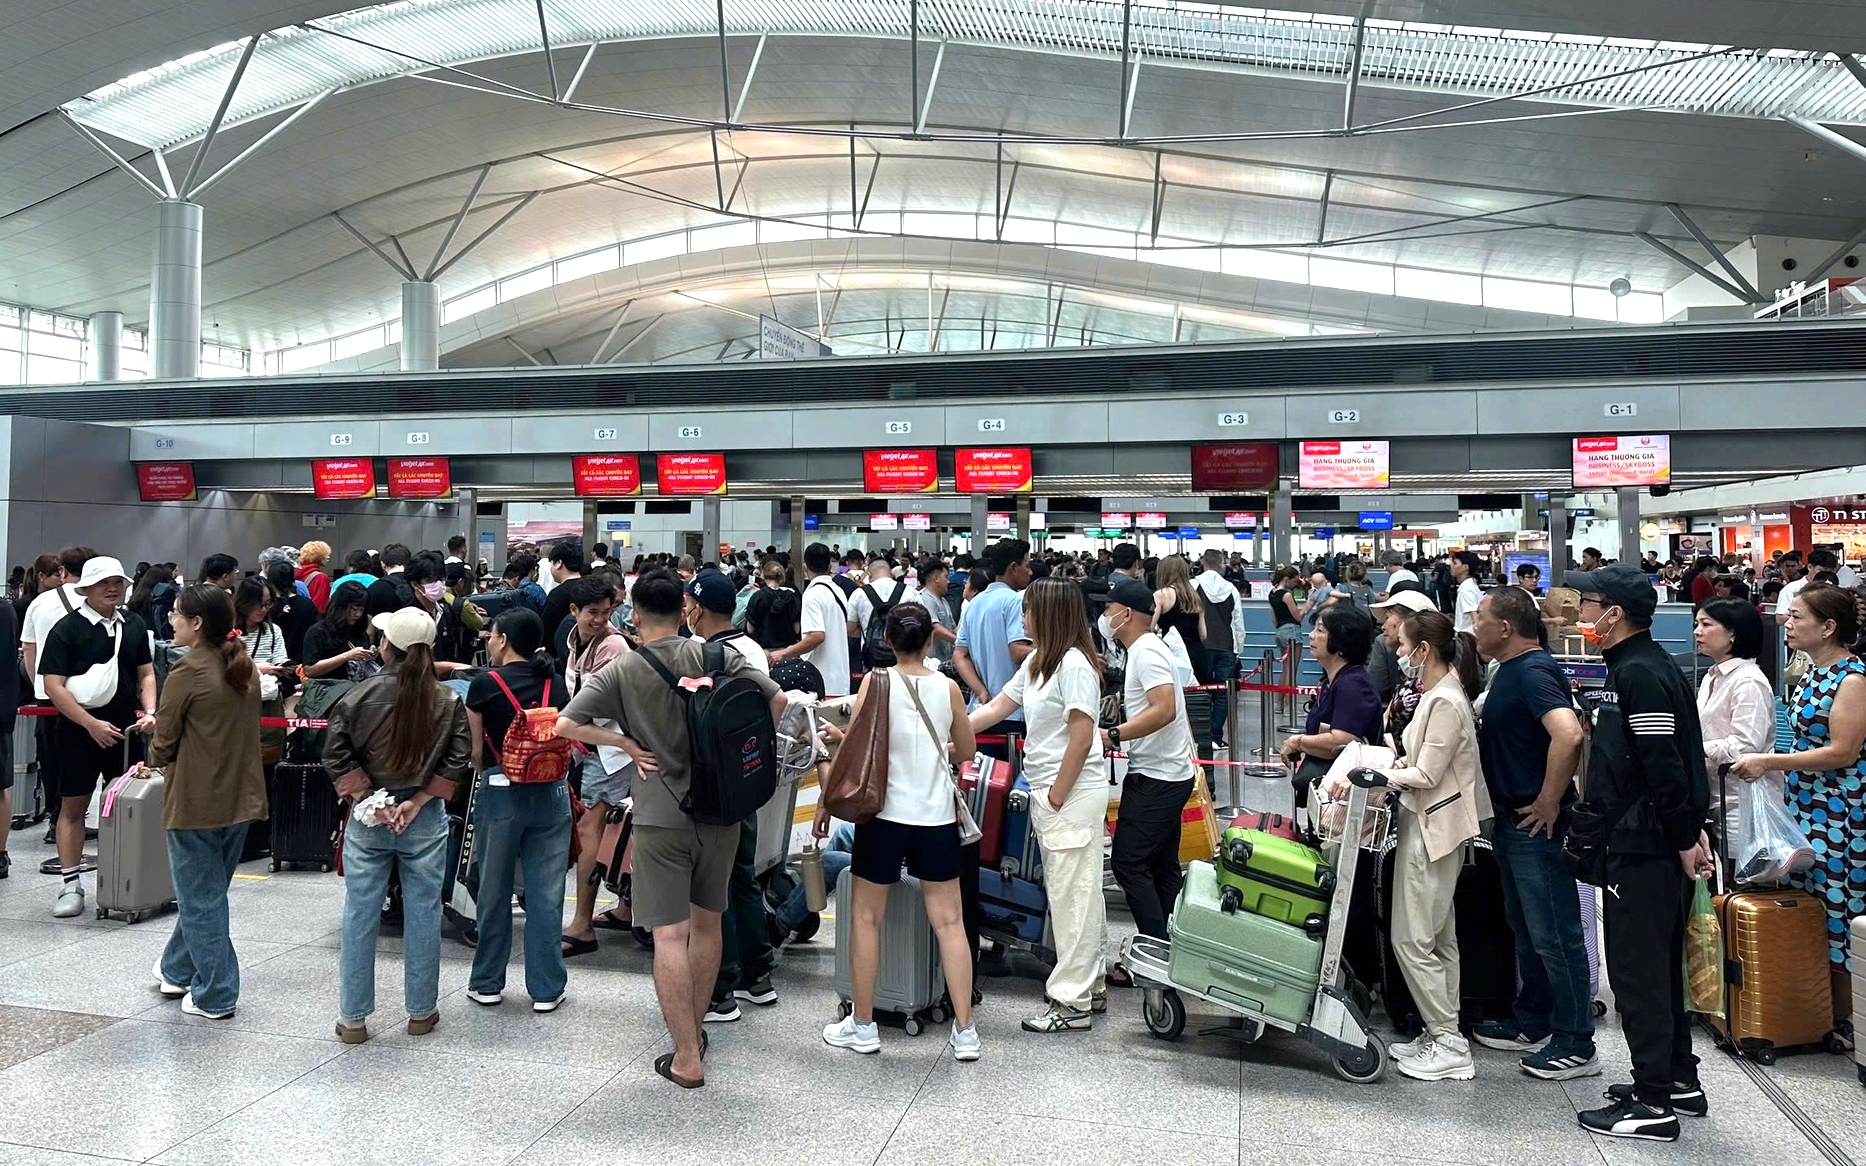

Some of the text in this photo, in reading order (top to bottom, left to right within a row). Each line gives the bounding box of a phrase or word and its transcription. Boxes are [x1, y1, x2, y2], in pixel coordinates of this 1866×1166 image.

[1610, 405, 1632, 414] G-1
[1224, 415, 1244, 424] G-3
[1334, 412, 1356, 421] G-2
[890, 424, 908, 432] G-5
[983, 421, 1002, 430] G-4
[598, 430, 614, 438] G-7
[682, 428, 698, 436] G-6
[334, 436, 350, 444] G-9
[411, 434, 427, 442] G-8
[156, 440, 174, 448] G-10
[1562, 667, 1597, 675] obifone
[1297, 687, 1317, 695] TIA
[287, 719, 309, 728] TIA
[462, 824, 474, 864] GROUP
